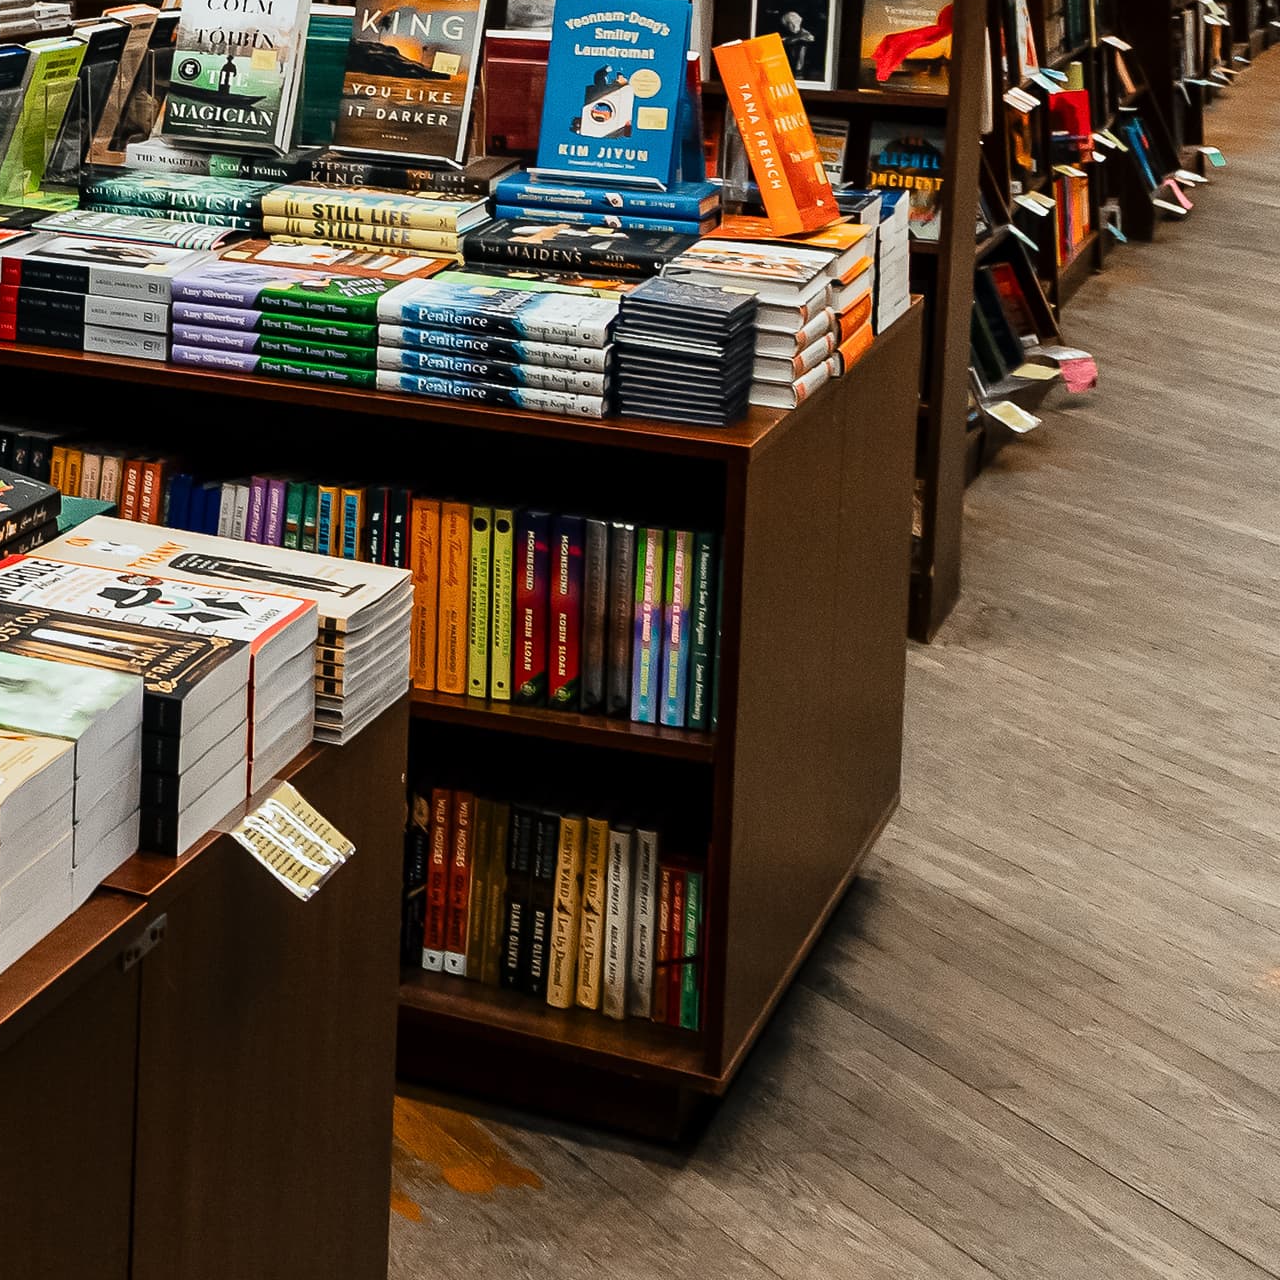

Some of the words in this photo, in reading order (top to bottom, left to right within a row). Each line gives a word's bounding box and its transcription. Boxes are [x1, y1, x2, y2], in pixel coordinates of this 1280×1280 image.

[359, 8, 466, 42] KING
[594, 27, 640, 44] Smiley
[350, 82, 391, 98] YOU
[404, 87, 453, 105] LIKE
[169, 101, 275, 127] MAGICIAN
[347, 103, 363, 118] IT
[375, 107, 449, 126] DARKER
[738, 83, 761, 125] TANA
[755, 130, 783, 190] FRENCH
[558, 144, 589, 157] KIM
[597, 147, 648, 162] JIYUN
[167, 191, 242, 213] TWIST
[311, 203, 365, 226] STILL
[370, 206, 411, 226] LIFE
[418, 307, 488, 328] Penitence
[124, 540, 189, 571] TYRANNY
[129, 641, 172, 667] EMILY
[145, 640, 206, 680] FRANKLIN
[510, 903, 521, 932] DIANE
[507, 933, 518, 970] OLIVER
